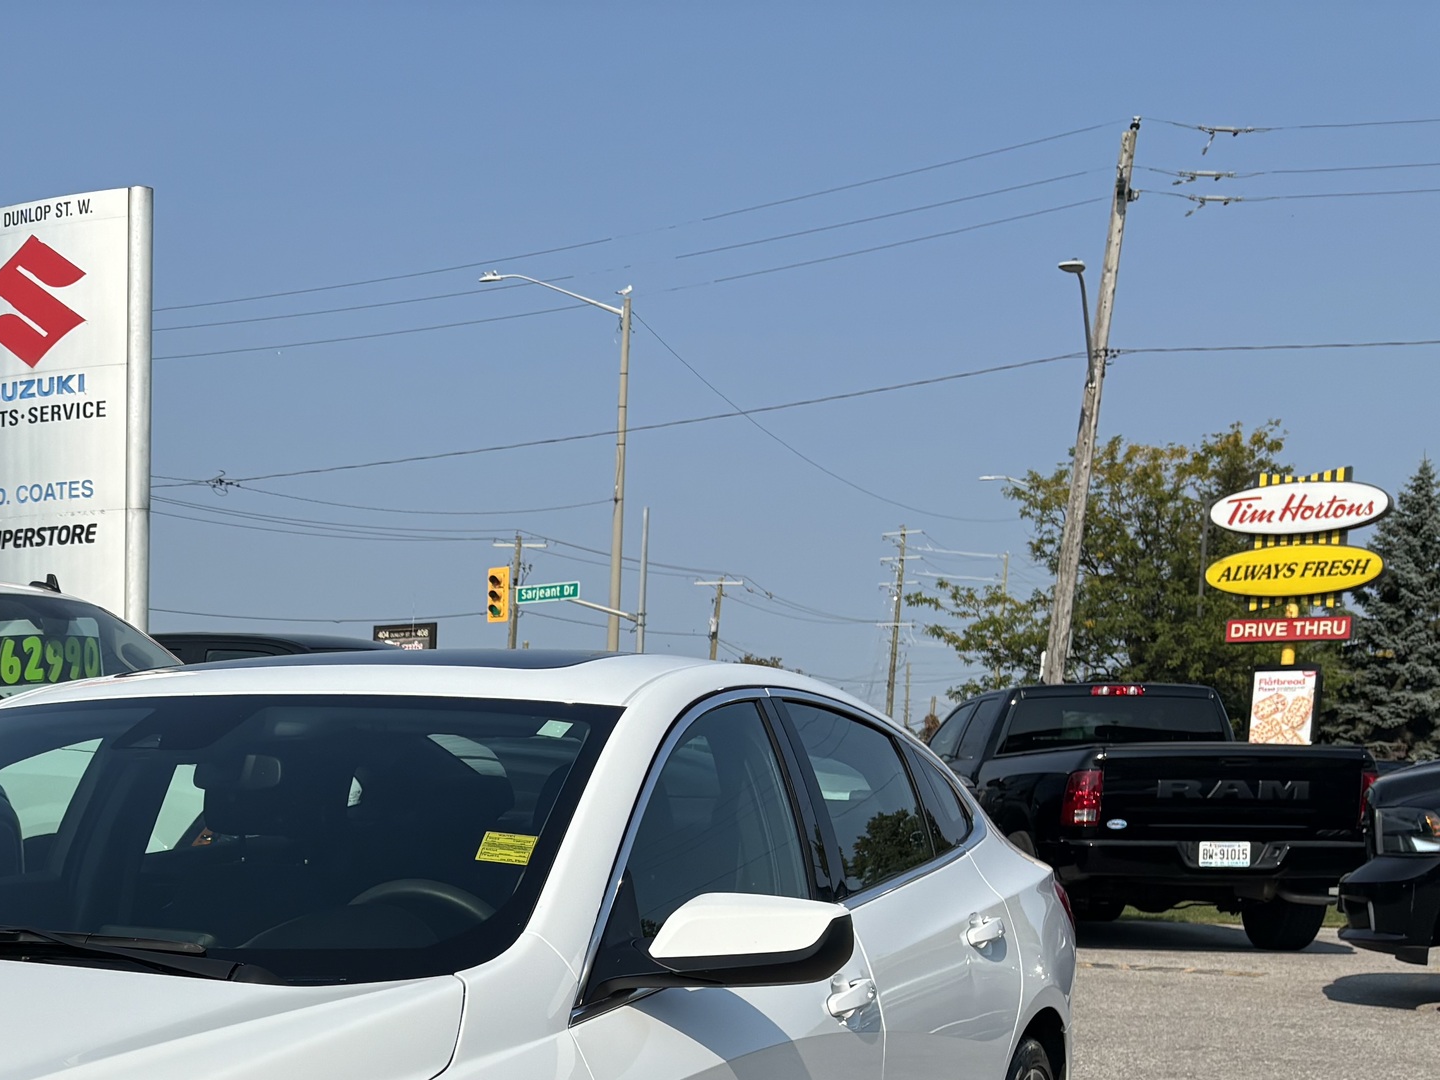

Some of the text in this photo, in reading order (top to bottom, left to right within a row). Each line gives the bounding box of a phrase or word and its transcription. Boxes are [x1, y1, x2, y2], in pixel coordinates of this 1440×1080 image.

[3, 204, 52, 229] DUNLOP
[55, 201, 73, 219] ST.
[77, 198, 94, 216] W.
[16, 479, 94, 504] COATES
[1227, 493, 1374, 526] Tim Hortons
[1217, 558, 1371, 583] ALWAYS FRESH
[521, 585, 575, 601] Sarjeant Dr
[1230, 619, 1347, 638] DRIVE THRU
[1157, 779, 1310, 799] RAM
